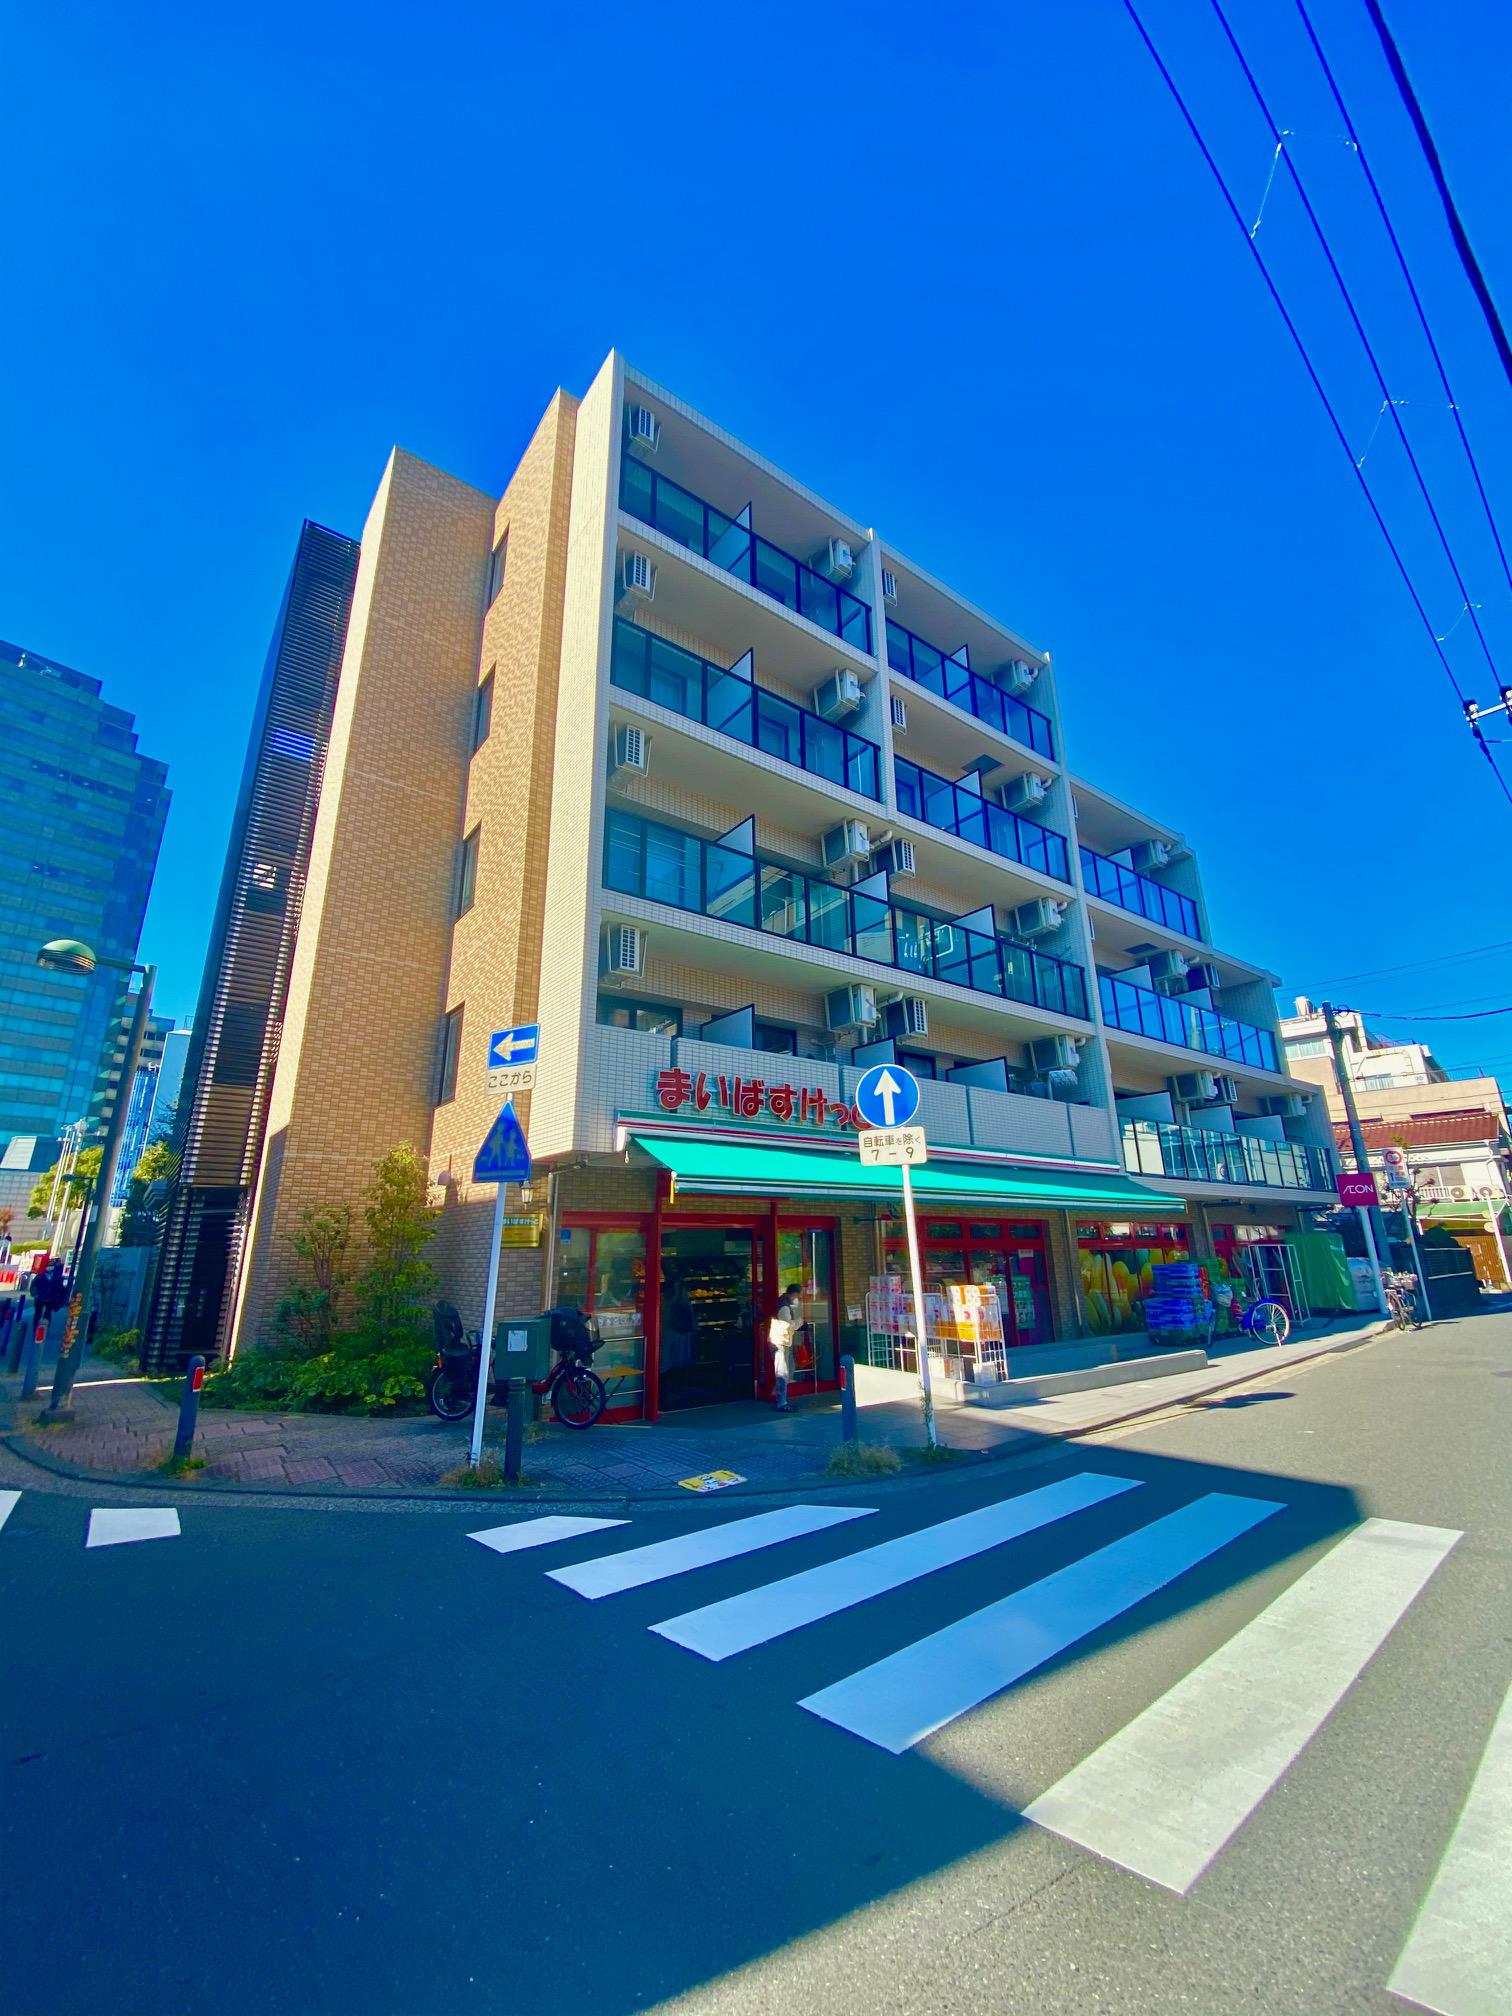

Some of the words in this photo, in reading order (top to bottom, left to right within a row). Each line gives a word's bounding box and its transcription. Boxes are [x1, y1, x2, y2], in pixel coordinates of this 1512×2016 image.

[488, 1070, 532, 1088] ここから
[863, 1133, 921, 1148] 自転車を除く
